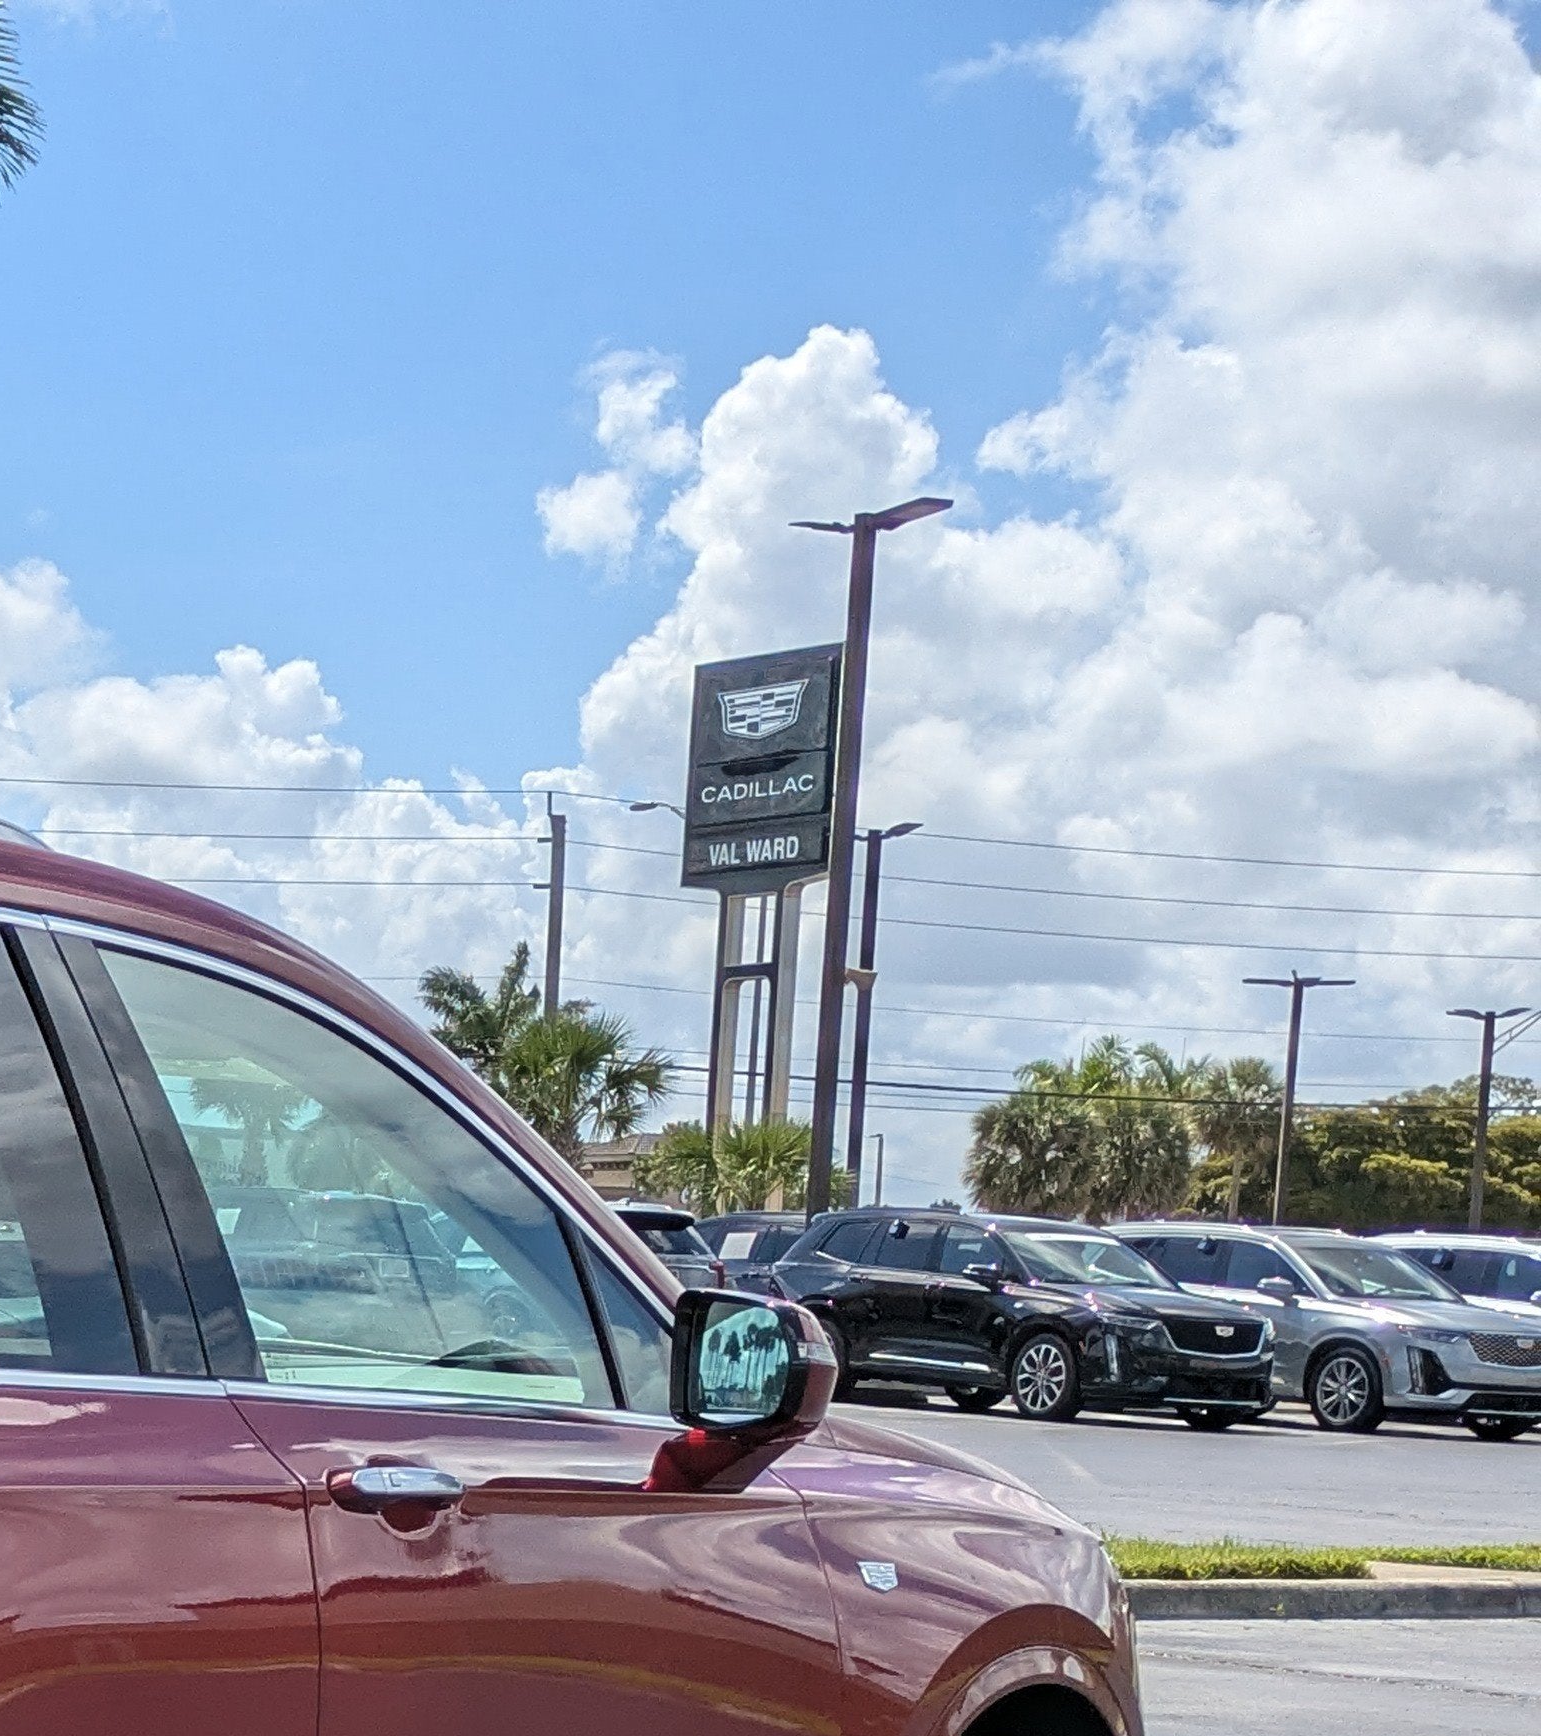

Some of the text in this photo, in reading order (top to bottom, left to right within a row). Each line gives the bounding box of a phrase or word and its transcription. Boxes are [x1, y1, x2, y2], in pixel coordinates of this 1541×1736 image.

[701, 774, 814, 804] CADILLAC
[709, 836, 799, 866] VAL WARD
